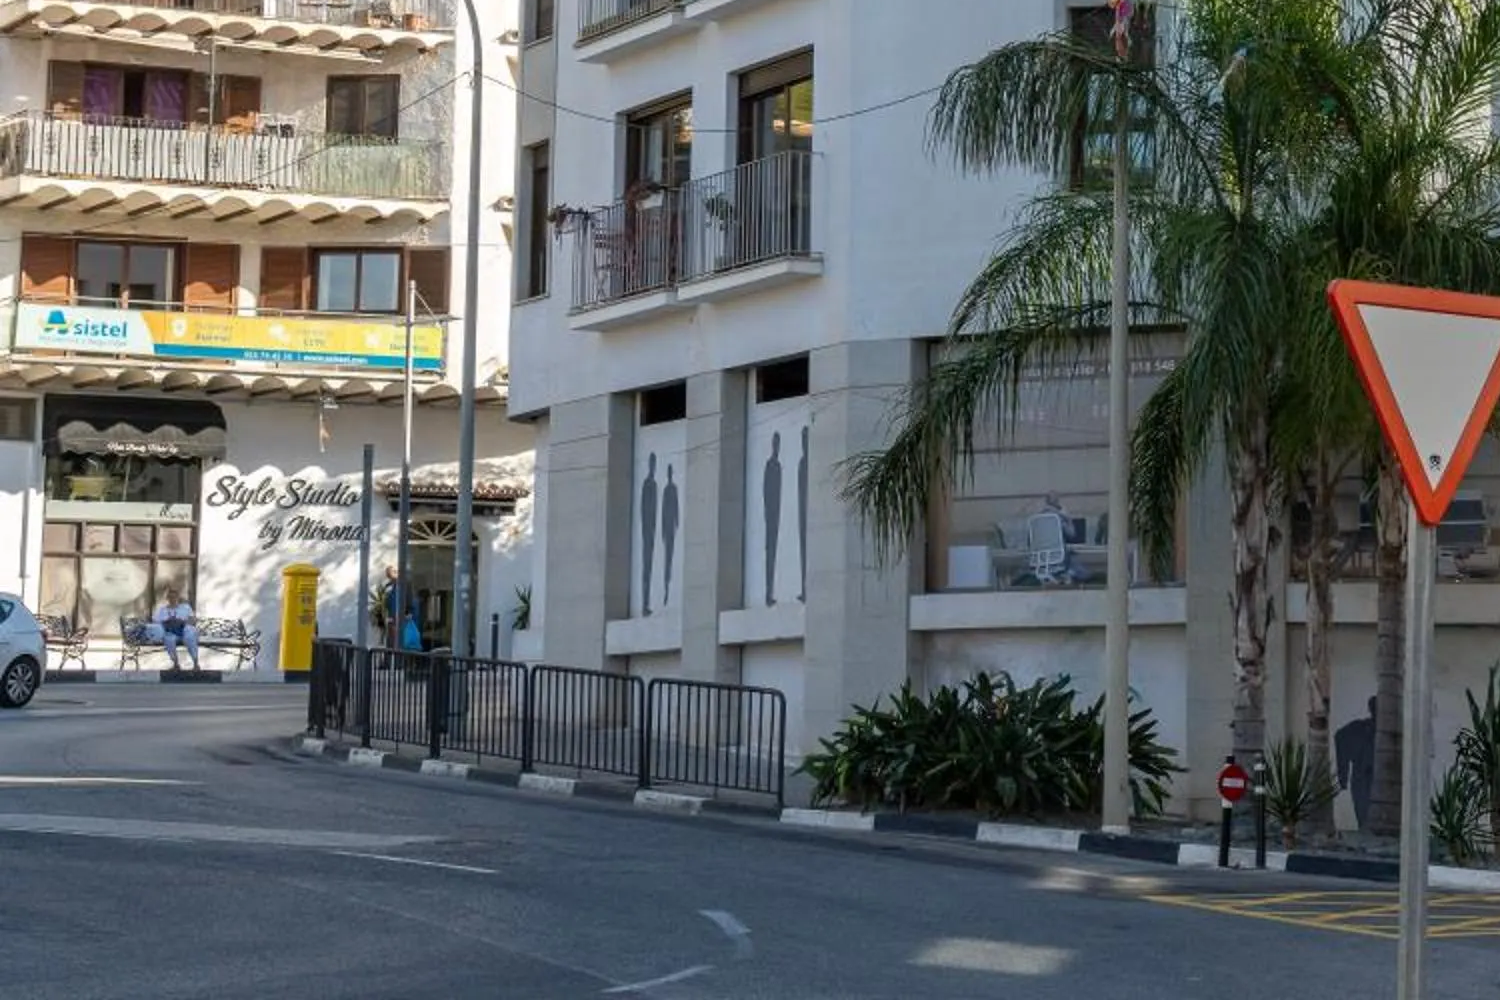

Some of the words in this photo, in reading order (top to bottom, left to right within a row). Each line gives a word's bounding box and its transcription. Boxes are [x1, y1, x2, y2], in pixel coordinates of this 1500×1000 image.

[206, 475, 277, 520] Style
[276, 479, 362, 509] Studio
[258, 520, 283, 550] by
[288, 515, 368, 541] Mirona
